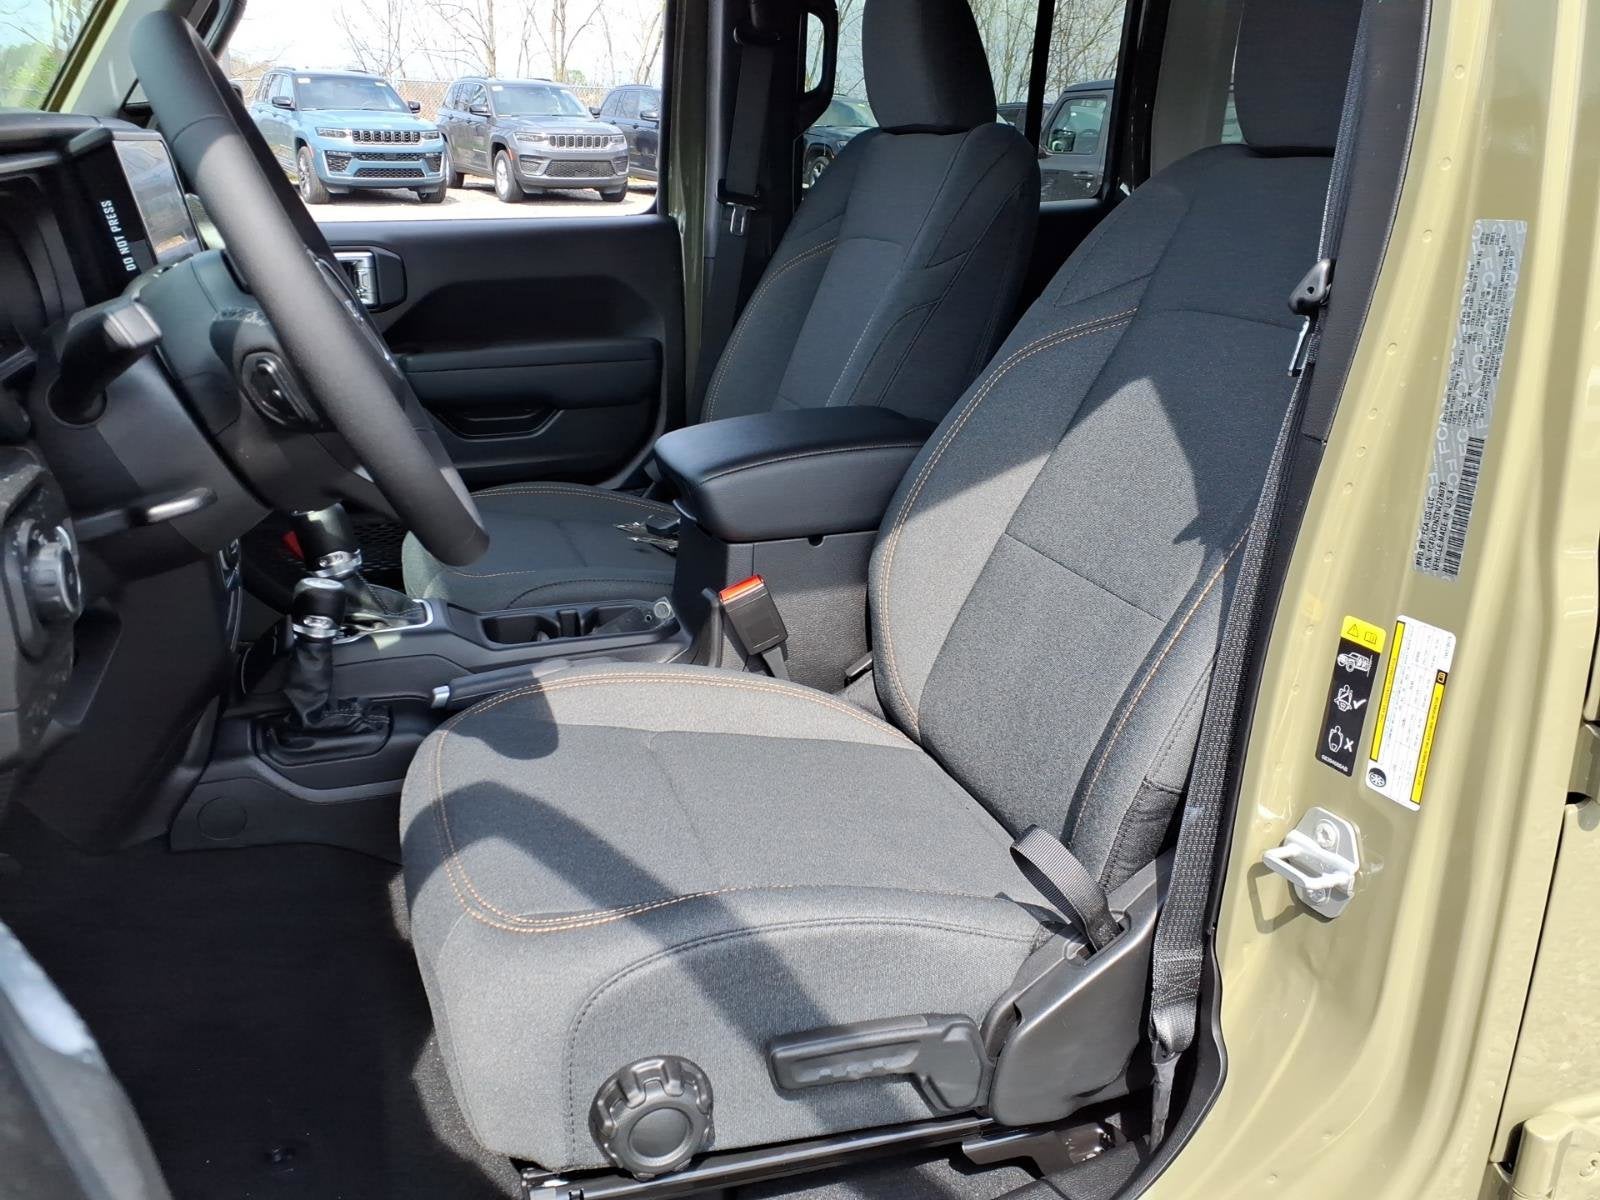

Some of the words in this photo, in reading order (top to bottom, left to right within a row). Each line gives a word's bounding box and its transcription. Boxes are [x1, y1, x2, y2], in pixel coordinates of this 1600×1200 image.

[101, 200, 121, 232] PRESS
[114, 236, 129, 254] NOT
[122, 257, 136, 271] DO
[1437, 521, 1447, 542] MADE
[1432, 544, 1443, 571] VEHICLE
